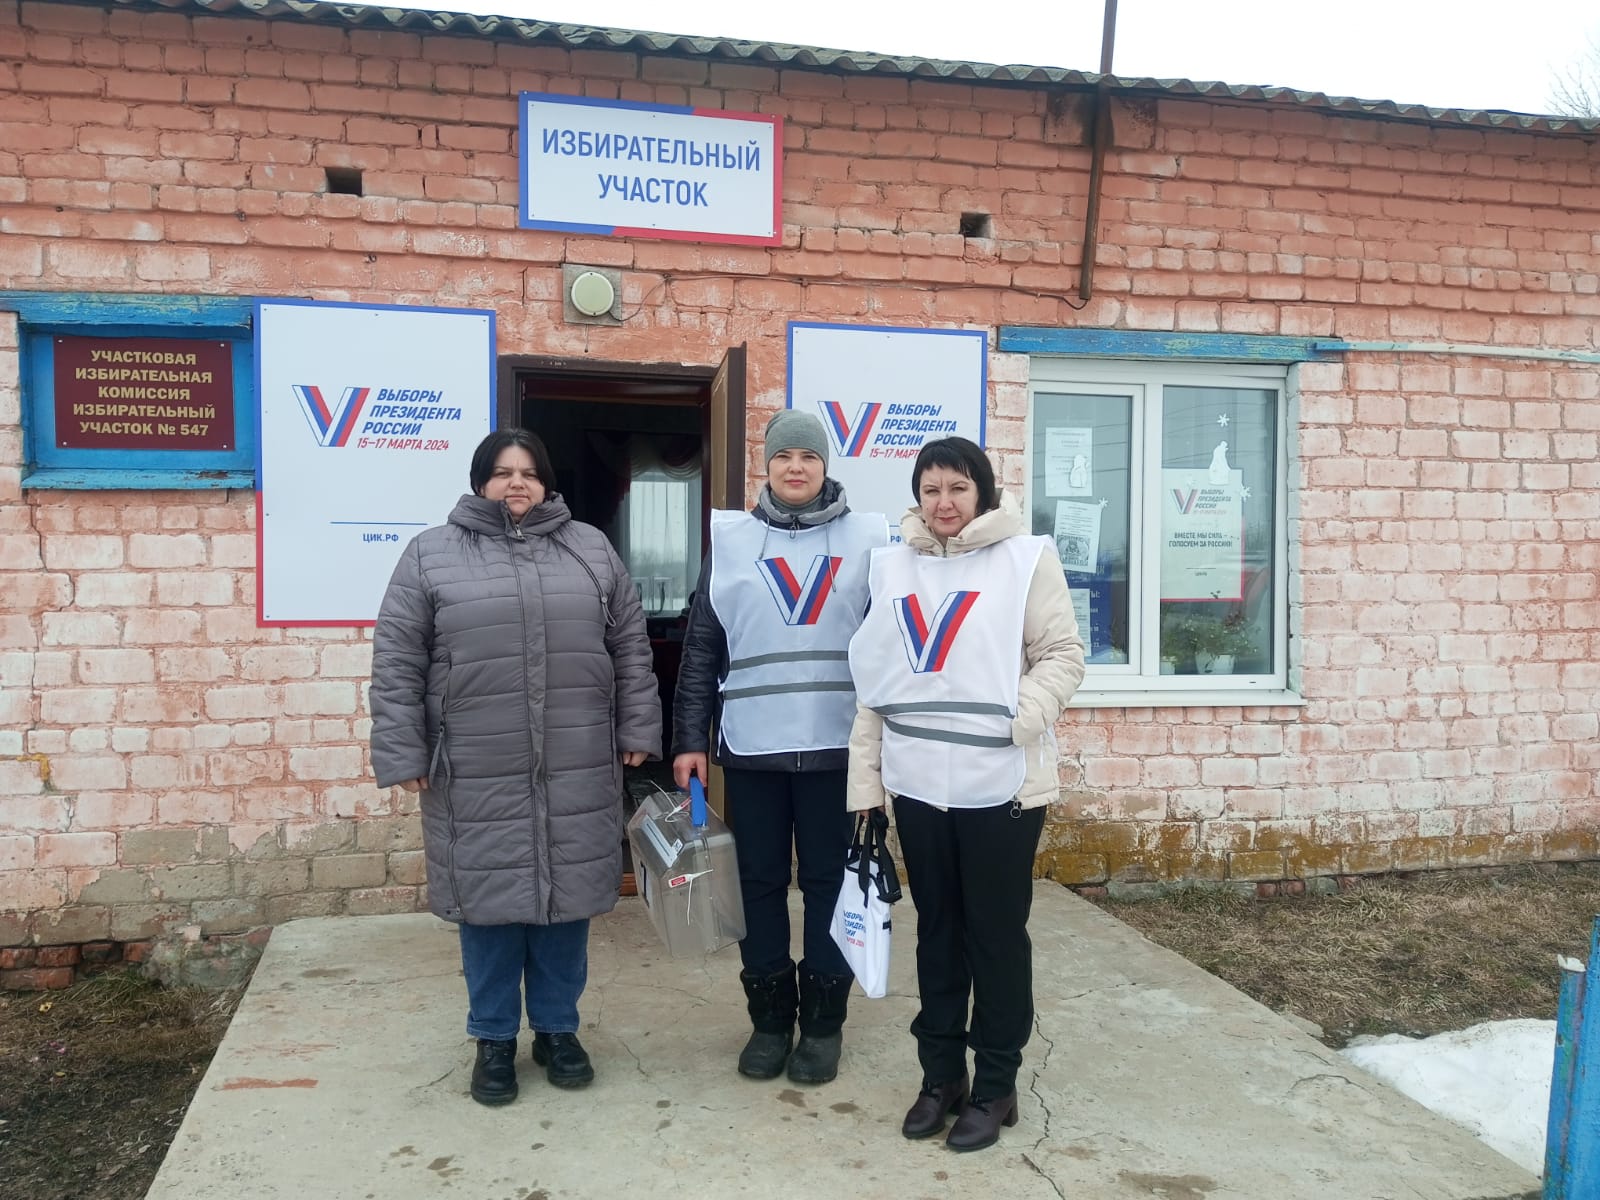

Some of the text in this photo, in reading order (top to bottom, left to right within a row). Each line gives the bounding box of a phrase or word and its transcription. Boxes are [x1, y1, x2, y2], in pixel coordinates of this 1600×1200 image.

[542, 127, 761, 172] ИЗБИРАТЕЛЬНЫЙ
[597, 173, 709, 207] УЧАСТОК
[90, 350, 197, 366] УЧАСТКОВАЯ
[75, 367, 213, 384] ИЗБИРАТЕЛЬНАЯ
[97, 385, 191, 401] КОМИССИЯ
[376, 388, 443, 403] ВЫБОРЫ
[73, 403, 216, 419] ИЗБИРАТЕЛЬНЫЙ
[369, 404, 462, 421] ПРЕЗИДЕНТА
[887, 403, 942, 417] ВЫБОРЫ
[79, 421, 209, 437] УЧАСТОК № 547
[362, 421, 423, 436] РОССИИ
[880, 418, 957, 433] ПРЕЗИДЕНТА
[387, 438, 423, 450] МАРТА
[423, 440, 450, 451] 2024
[874, 433, 924, 447] РОССИИ
[894, 448, 920, 460] МАРТ
[362, 533, 399, 543] ЦИК.РФ
